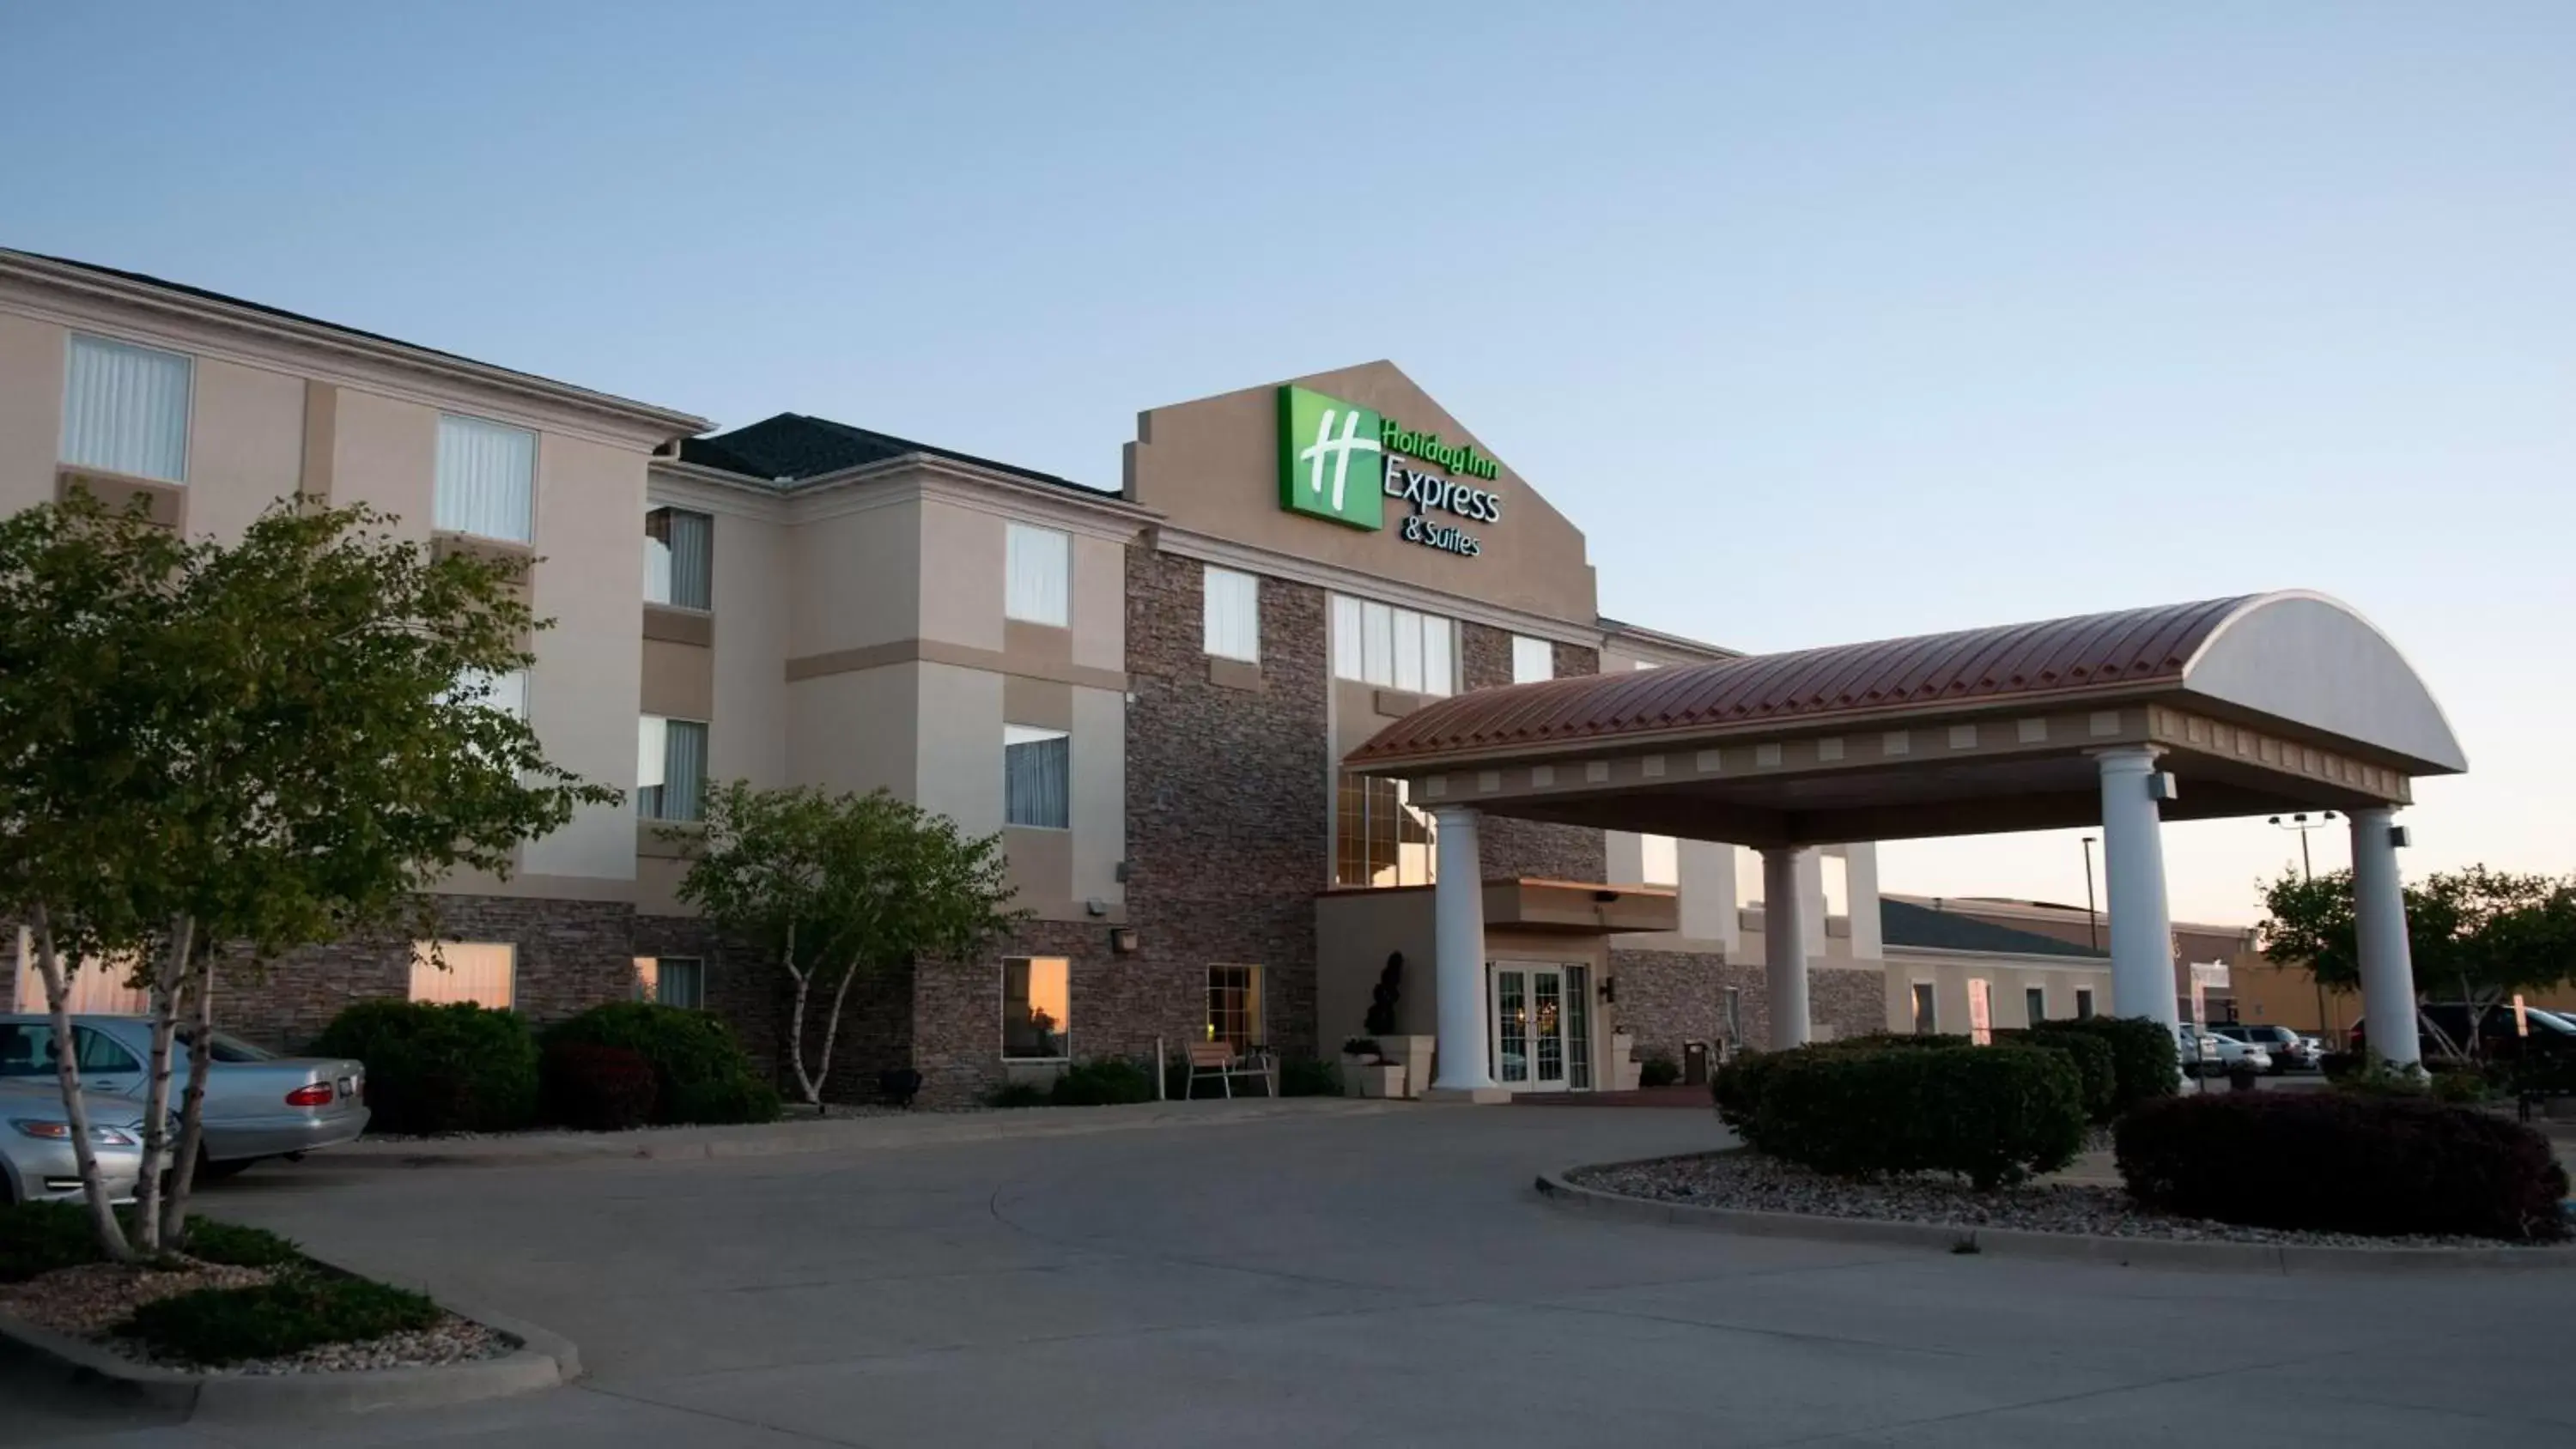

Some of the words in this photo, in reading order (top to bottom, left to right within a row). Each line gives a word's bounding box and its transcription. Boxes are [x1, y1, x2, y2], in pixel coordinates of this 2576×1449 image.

[1382, 419, 1465, 476] Holiday
[1467, 444, 1499, 480] Inn
[1383, 454, 1501, 524] Express
[1406, 514, 1422, 541] &
[1425, 520, 1482, 557] Suites
